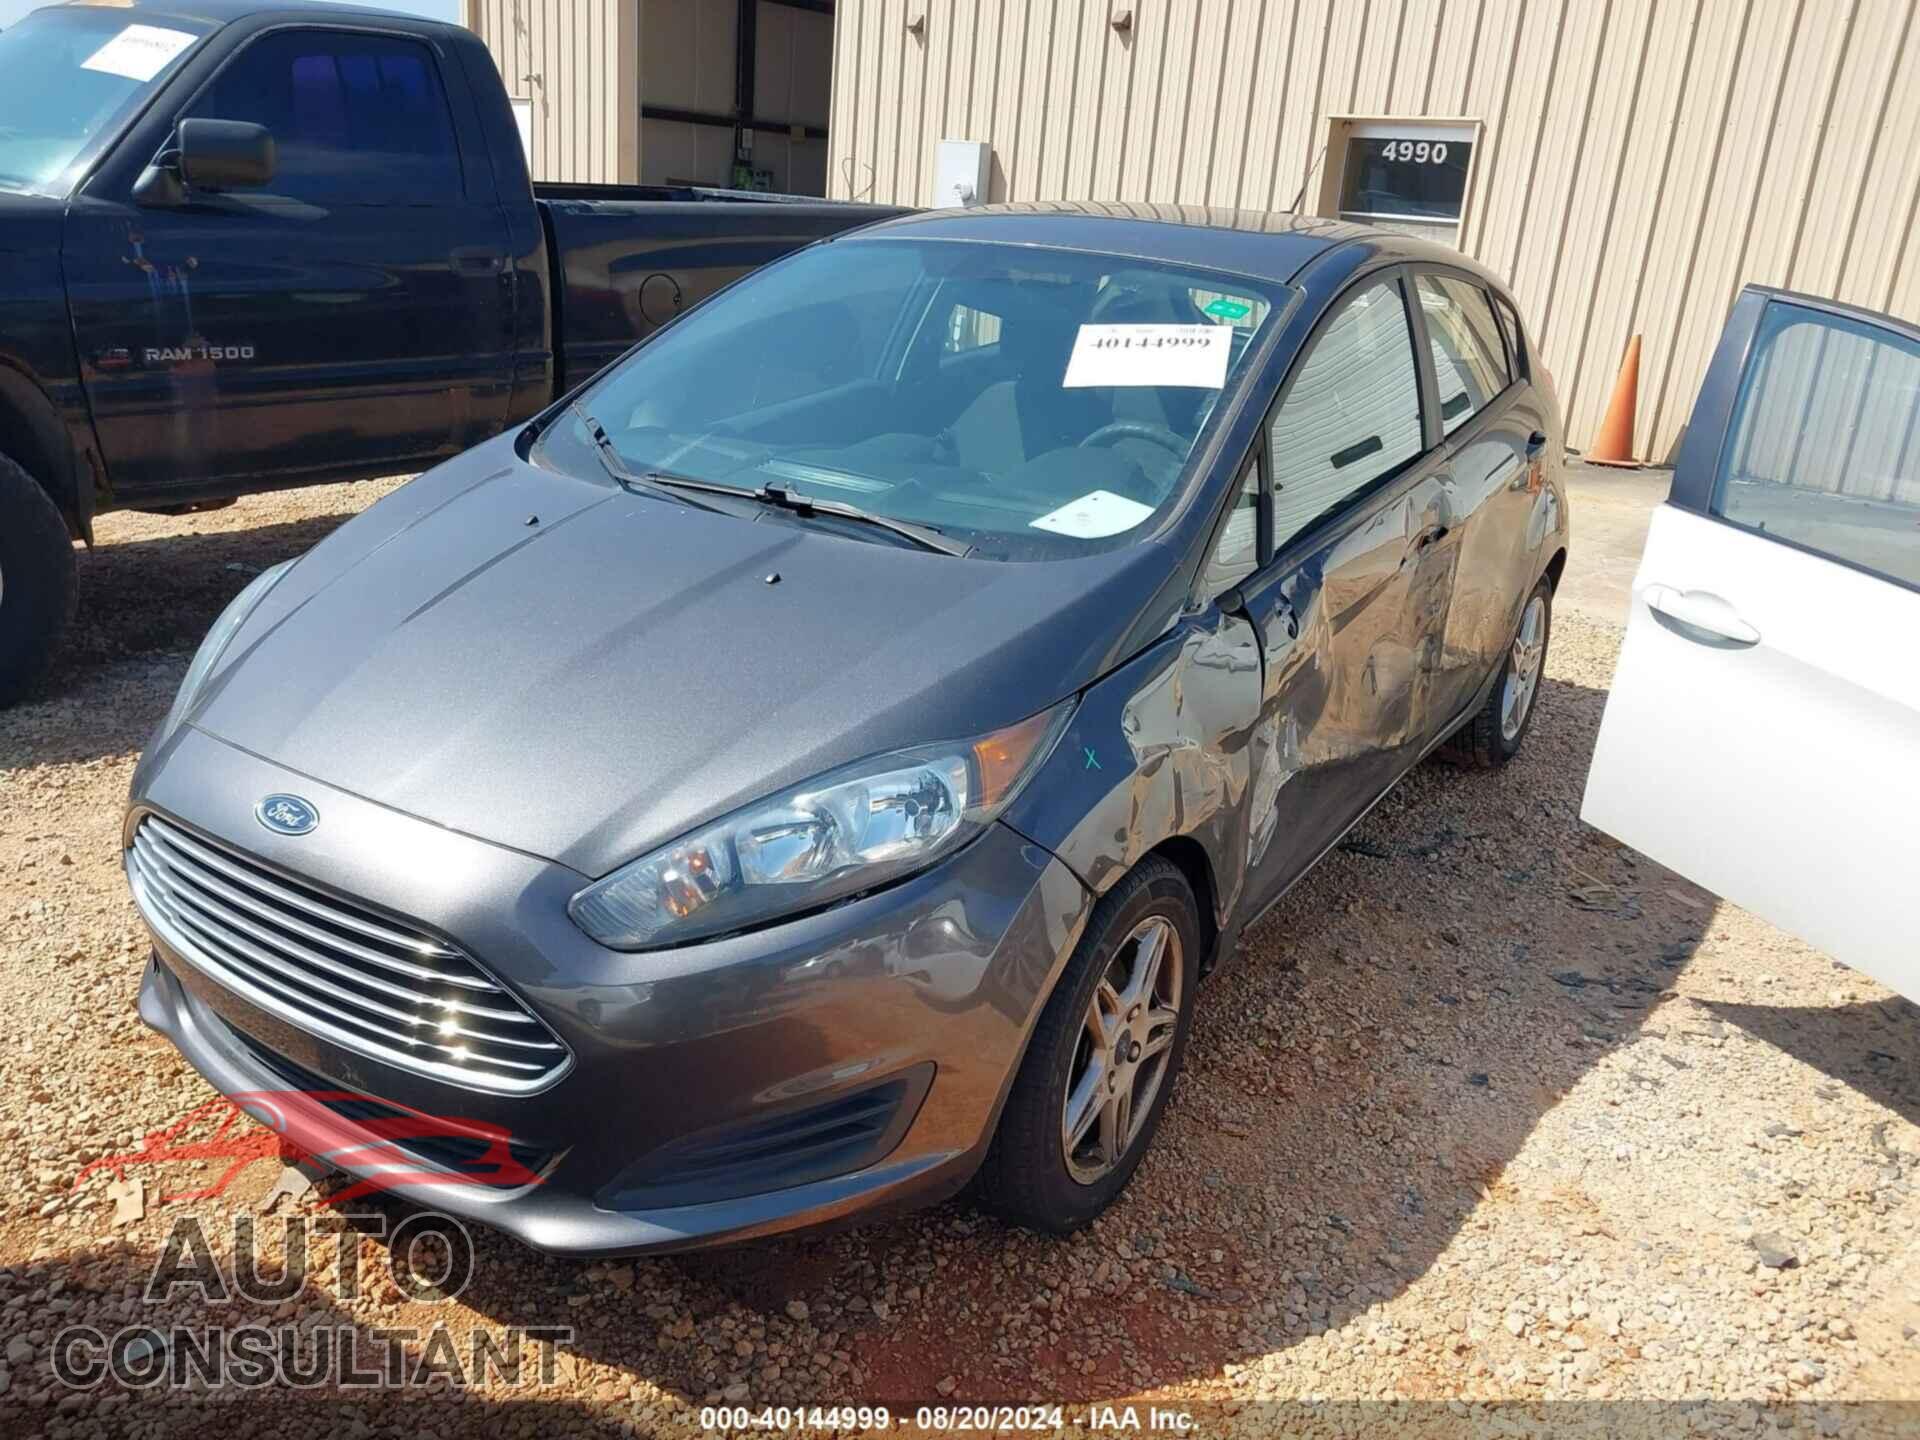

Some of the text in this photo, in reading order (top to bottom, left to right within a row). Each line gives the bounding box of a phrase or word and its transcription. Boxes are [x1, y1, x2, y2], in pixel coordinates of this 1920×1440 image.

[1382, 141, 1448, 164] 4990
[145, 348, 193, 361] RAM
[198, 346, 255, 360] 1500
[267, 801, 306, 827] Ford
